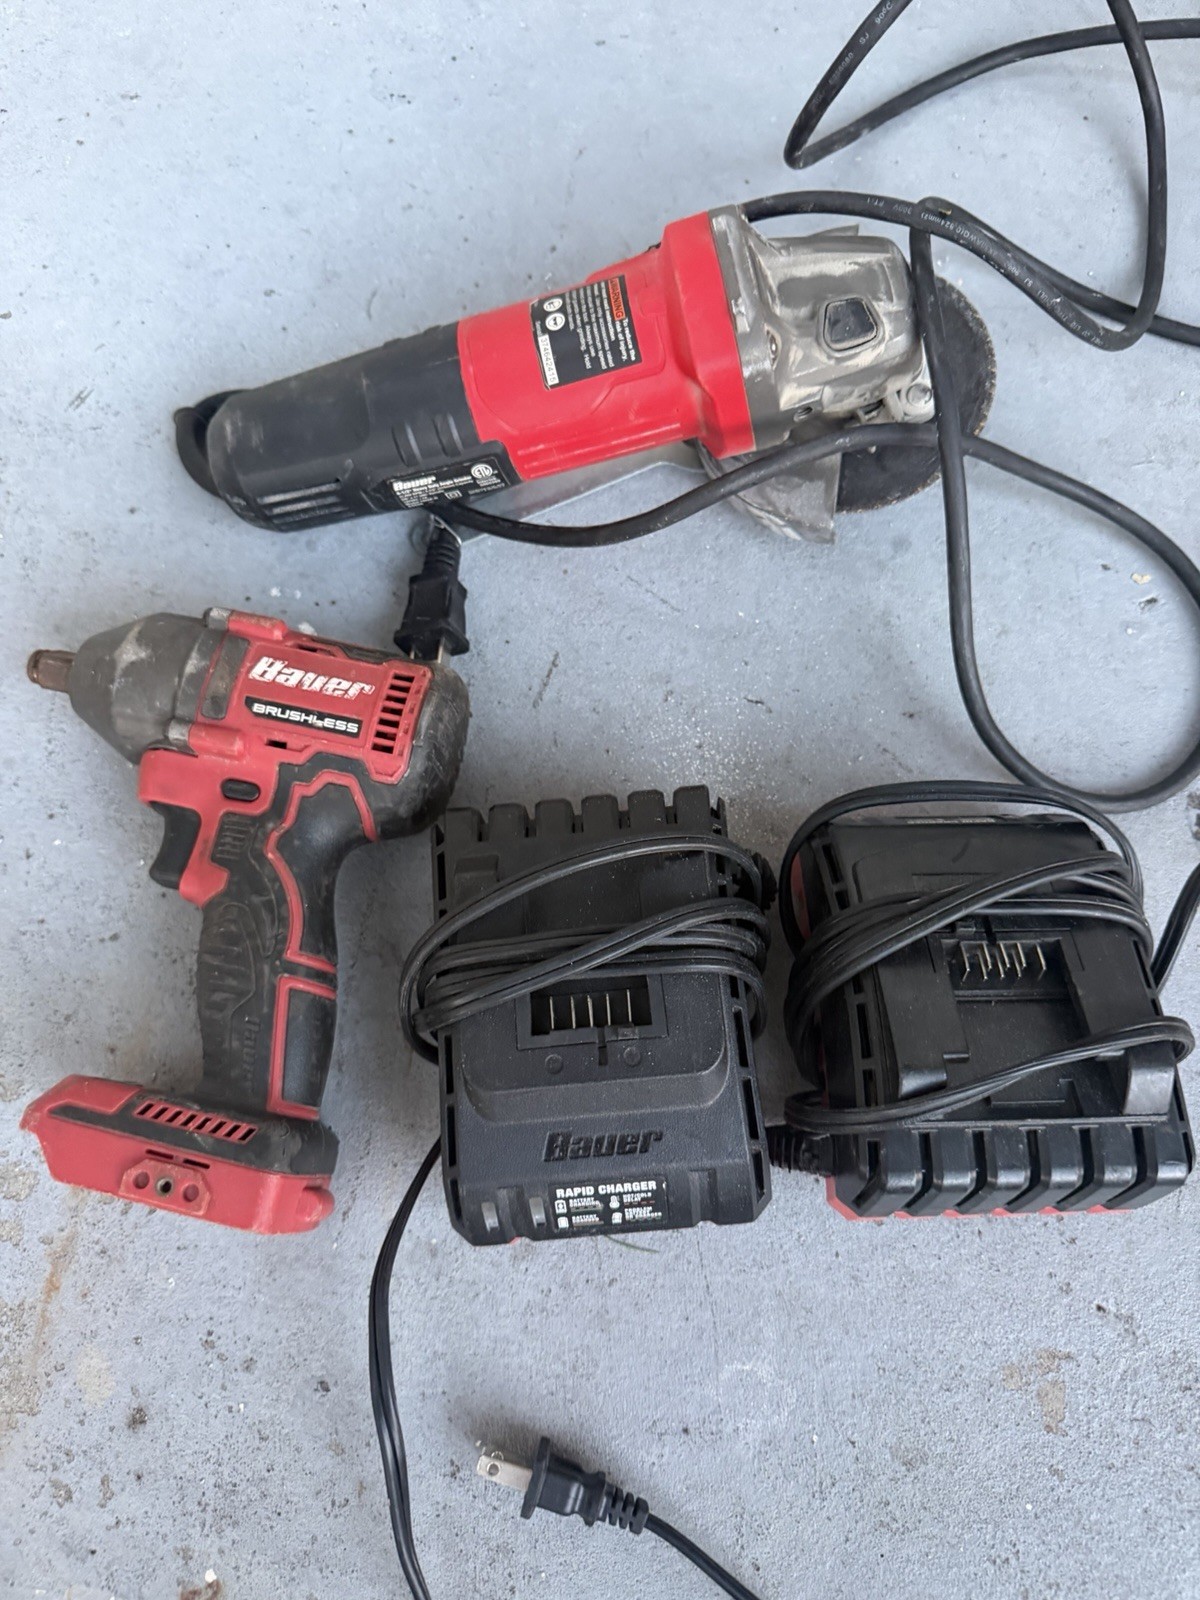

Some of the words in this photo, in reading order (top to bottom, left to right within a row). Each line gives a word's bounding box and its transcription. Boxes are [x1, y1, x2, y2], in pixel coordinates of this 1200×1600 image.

[609, 282, 624, 319] WARNING
[393, 475, 436, 491] Bauer
[248, 656, 376, 700] Bauer
[252, 703, 359, 733] BRUSHLESS
[543, 1129, 664, 1162] Bauer
[555, 1186, 595, 1198] RAPID
[598, 1180, 657, 1195] CHARGER
